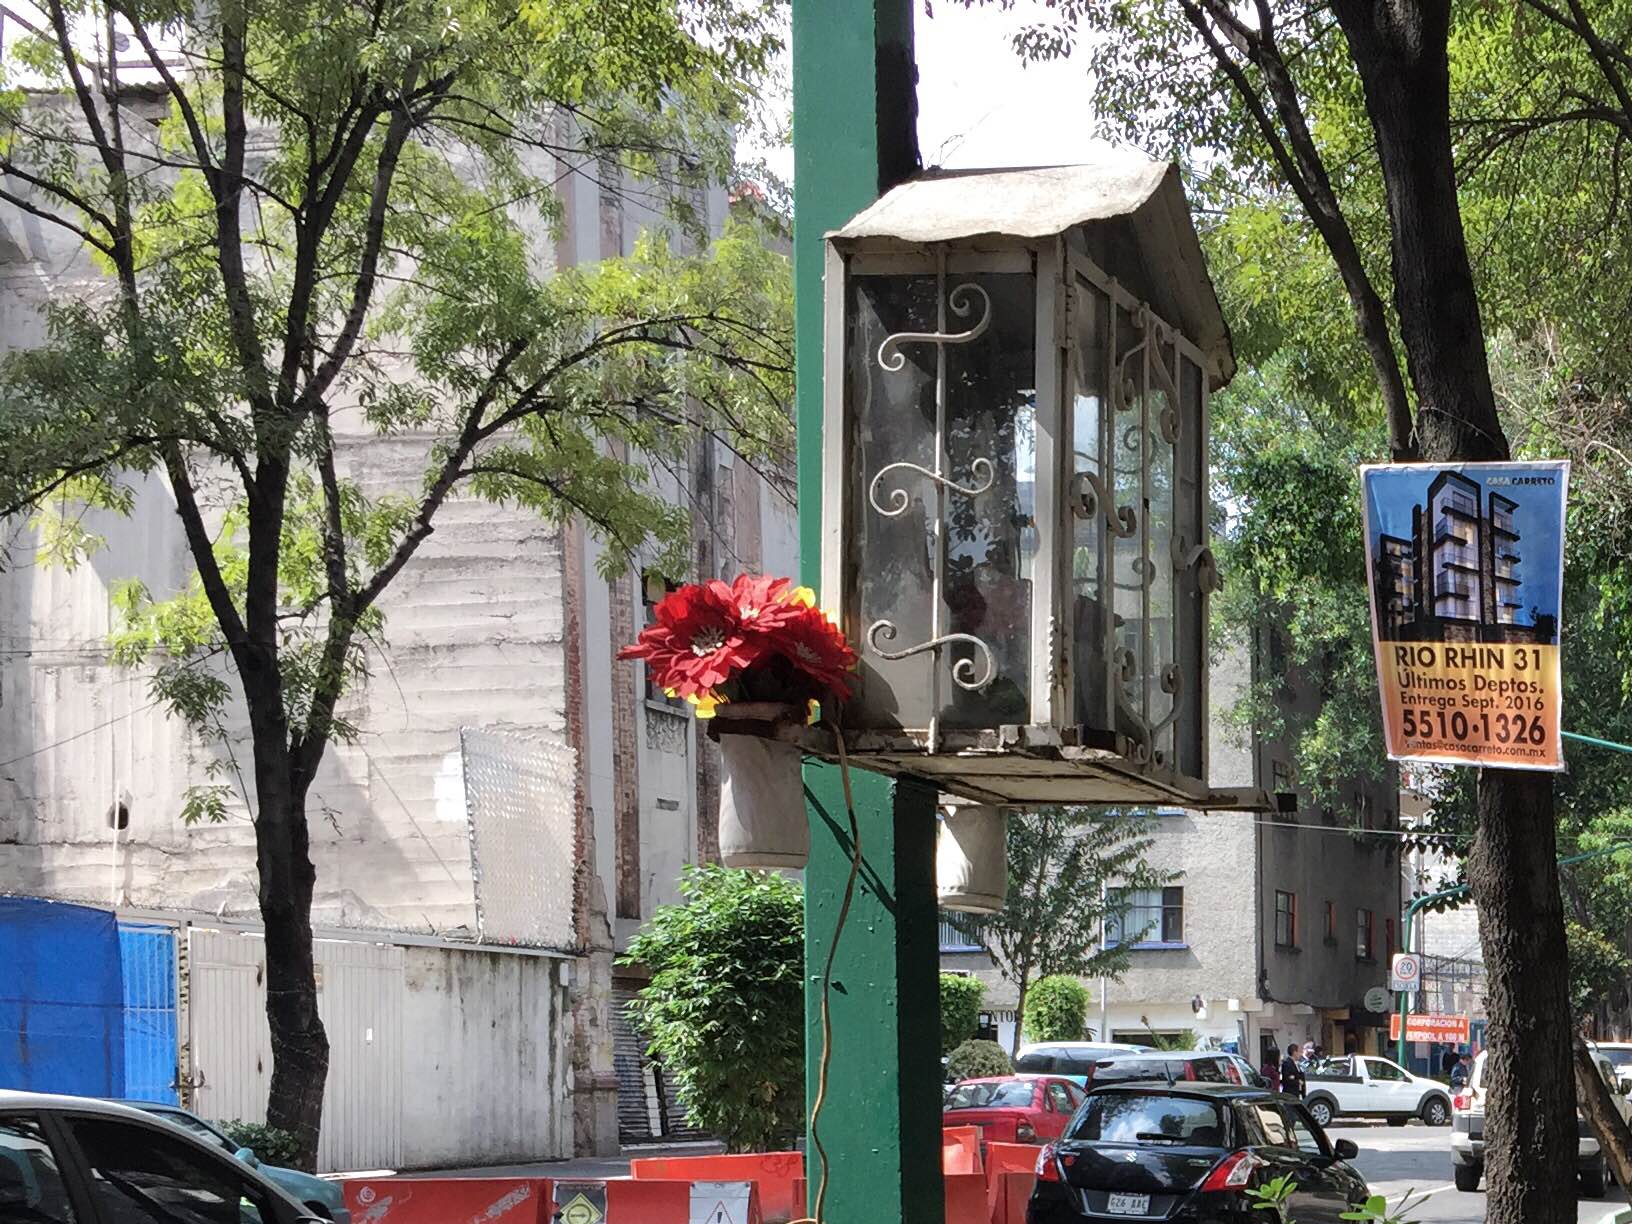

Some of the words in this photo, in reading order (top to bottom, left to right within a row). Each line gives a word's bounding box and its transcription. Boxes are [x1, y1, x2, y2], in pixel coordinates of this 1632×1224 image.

[1394, 645, 1436, 668] RIO
[1445, 647, 1505, 670] RHIN
[1513, 648, 1541, 671] 31
[1397, 667, 1467, 691] Últimos
[1474, 674, 1545, 697] Deptos.
[1400, 691, 1456, 710] Entrega
[1462, 694, 1500, 712] Sept.
[1505, 695, 1545, 711] 2016
[1405, 739, 1547, 758] ntas@casacarreto.com.mx
